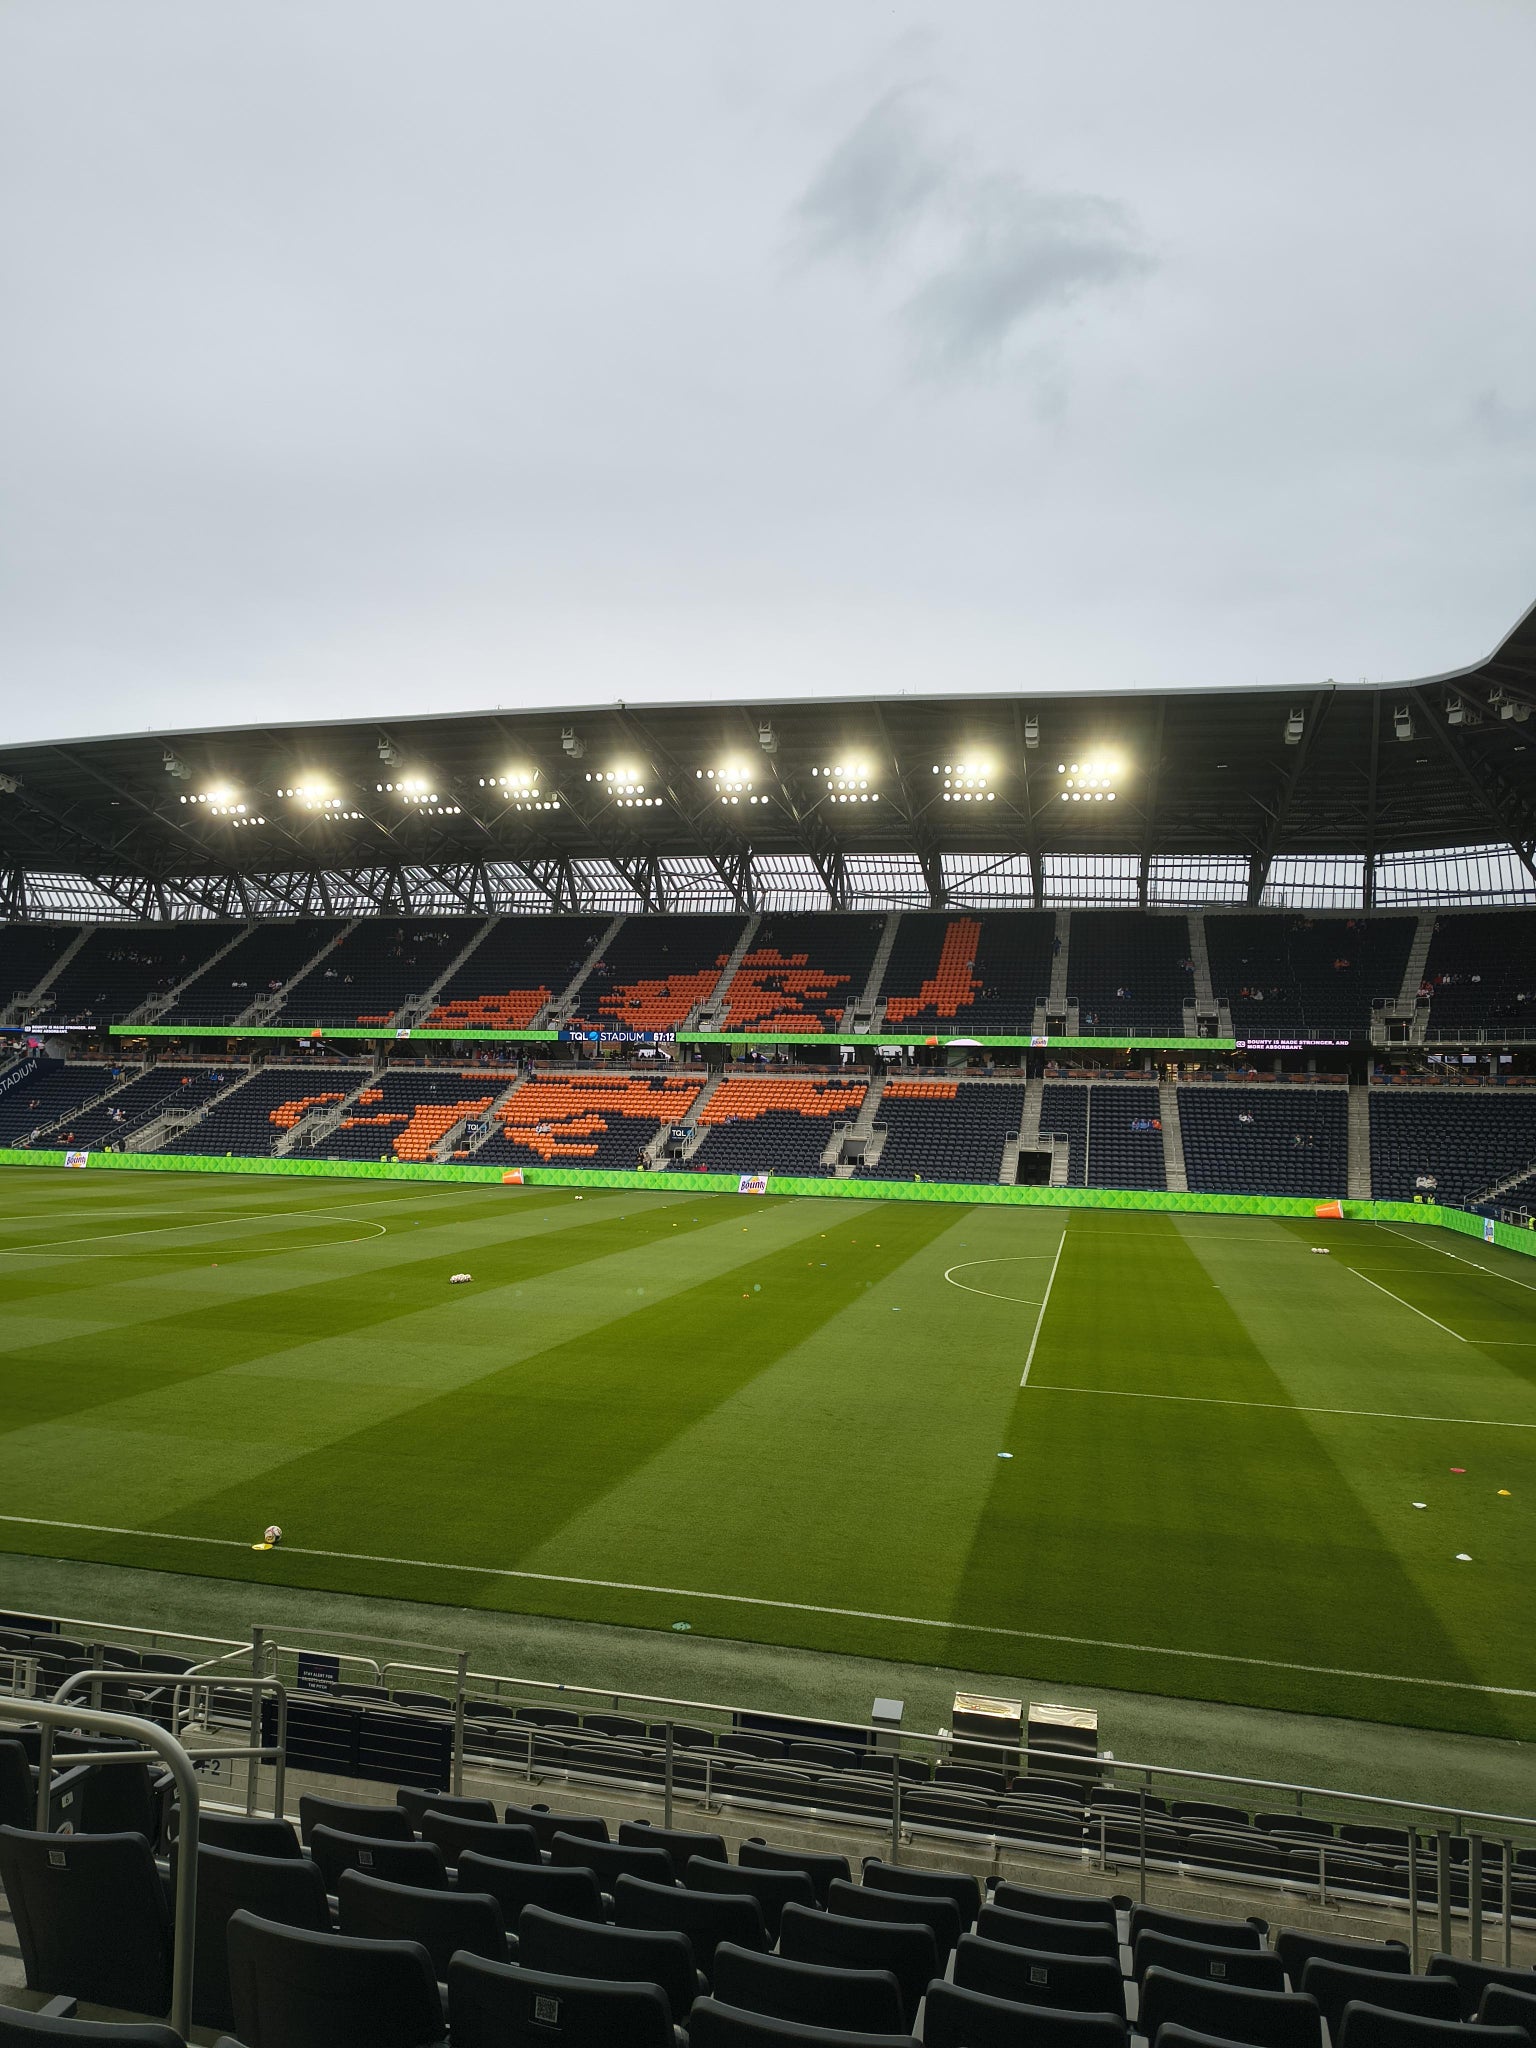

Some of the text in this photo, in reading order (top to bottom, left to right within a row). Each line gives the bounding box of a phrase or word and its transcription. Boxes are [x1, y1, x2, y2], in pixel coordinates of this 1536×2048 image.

[569, 1032, 645, 1041] TQL STADIUM
[653, 1032, 675, 1042] 67:12
[671, 1129, 687, 1137] TQL
[740, 1181, 766, 1191] Bounty
